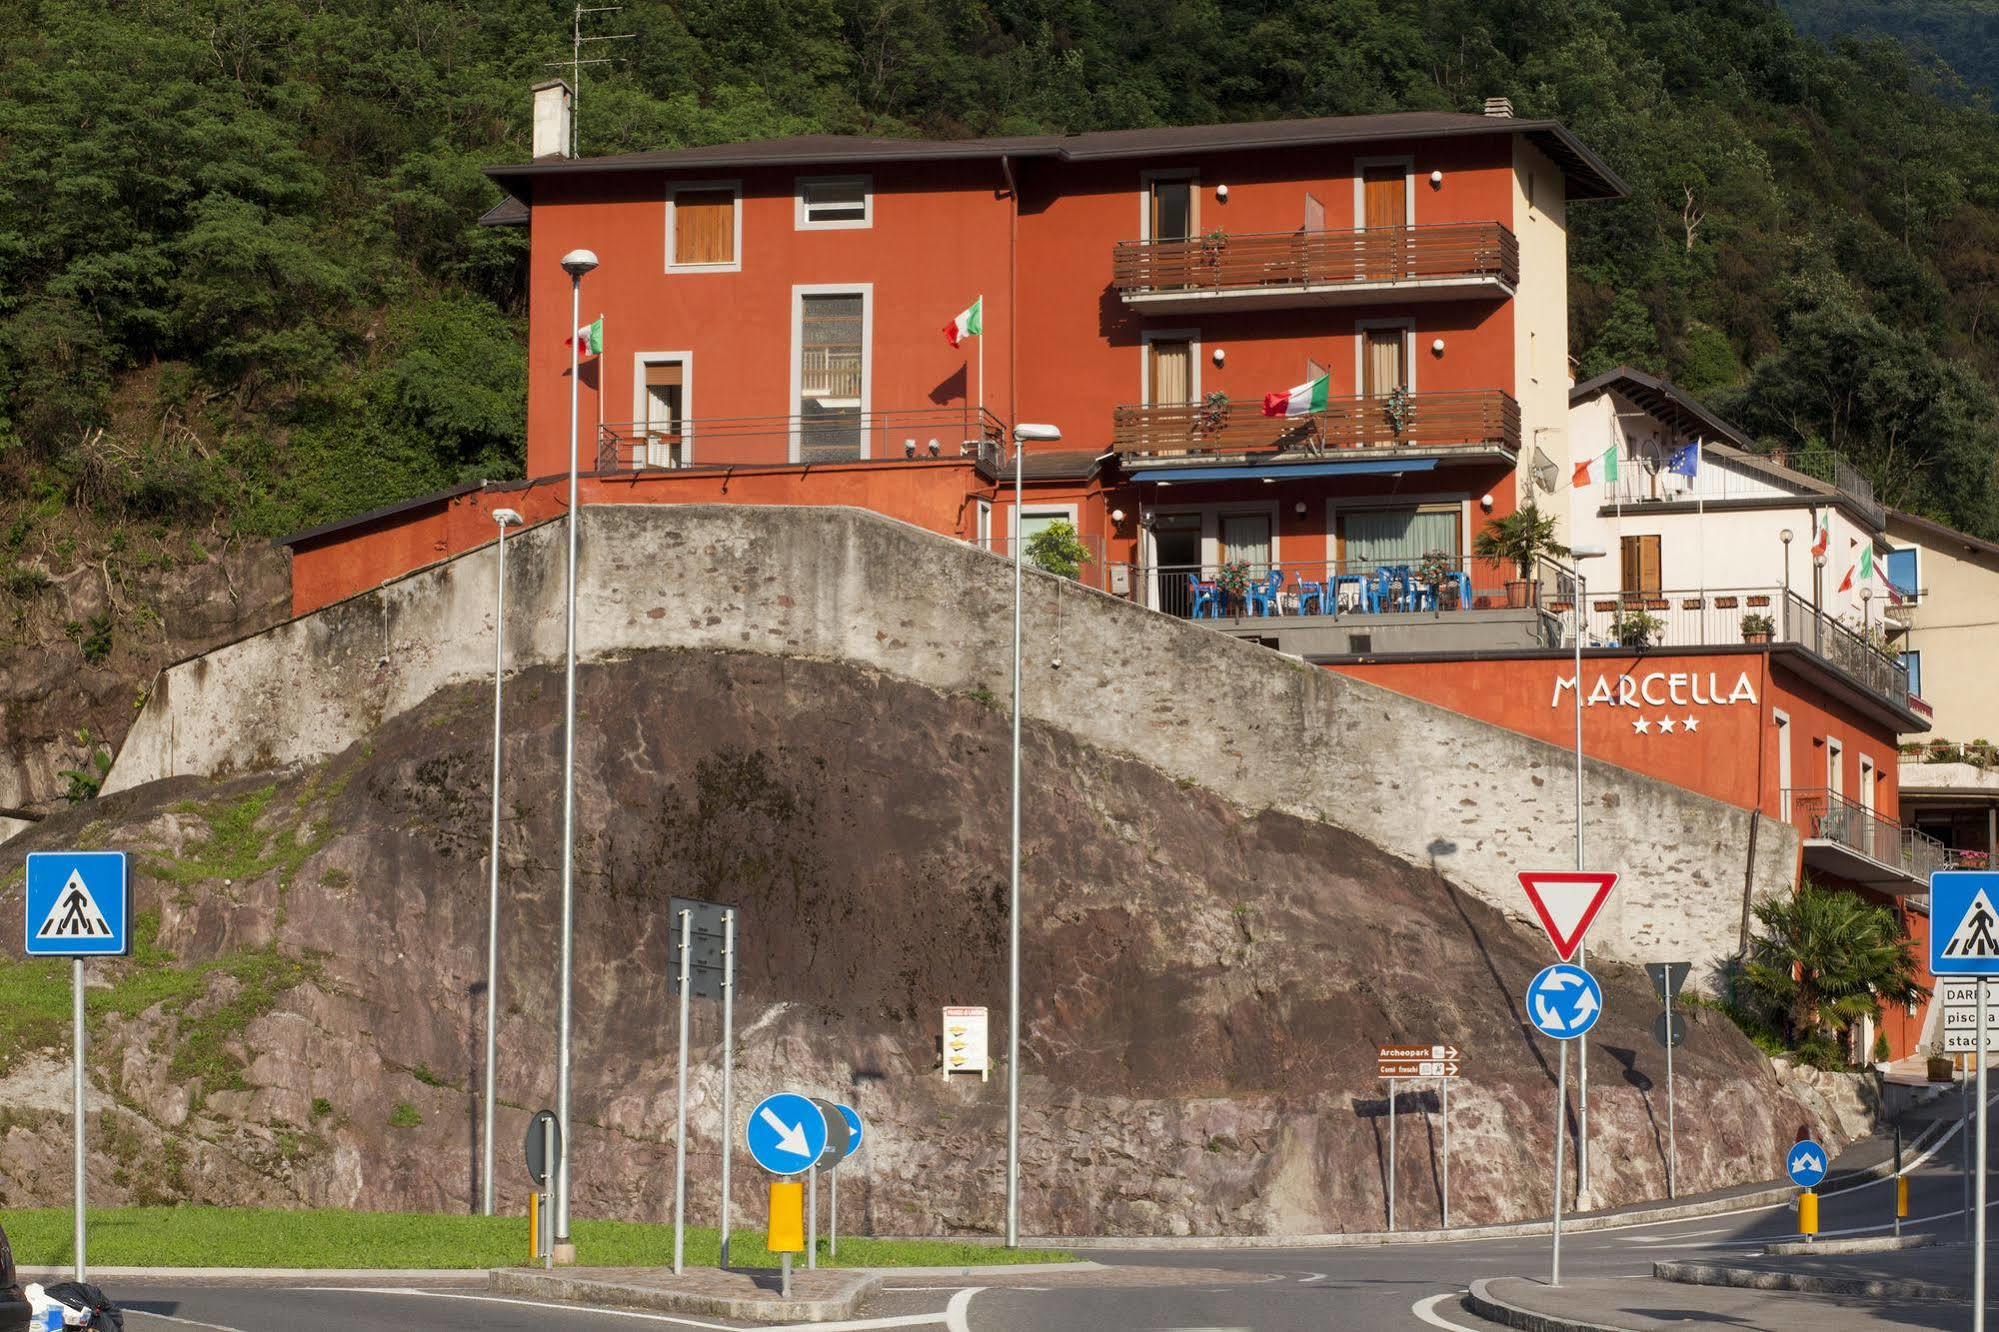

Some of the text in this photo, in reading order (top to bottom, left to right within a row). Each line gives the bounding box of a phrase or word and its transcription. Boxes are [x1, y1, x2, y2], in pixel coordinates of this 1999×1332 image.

[1551, 671, 1758, 708] MARCELLA
[1948, 1011, 1995, 1024] pisca
[1948, 1036, 1991, 1046] stao
